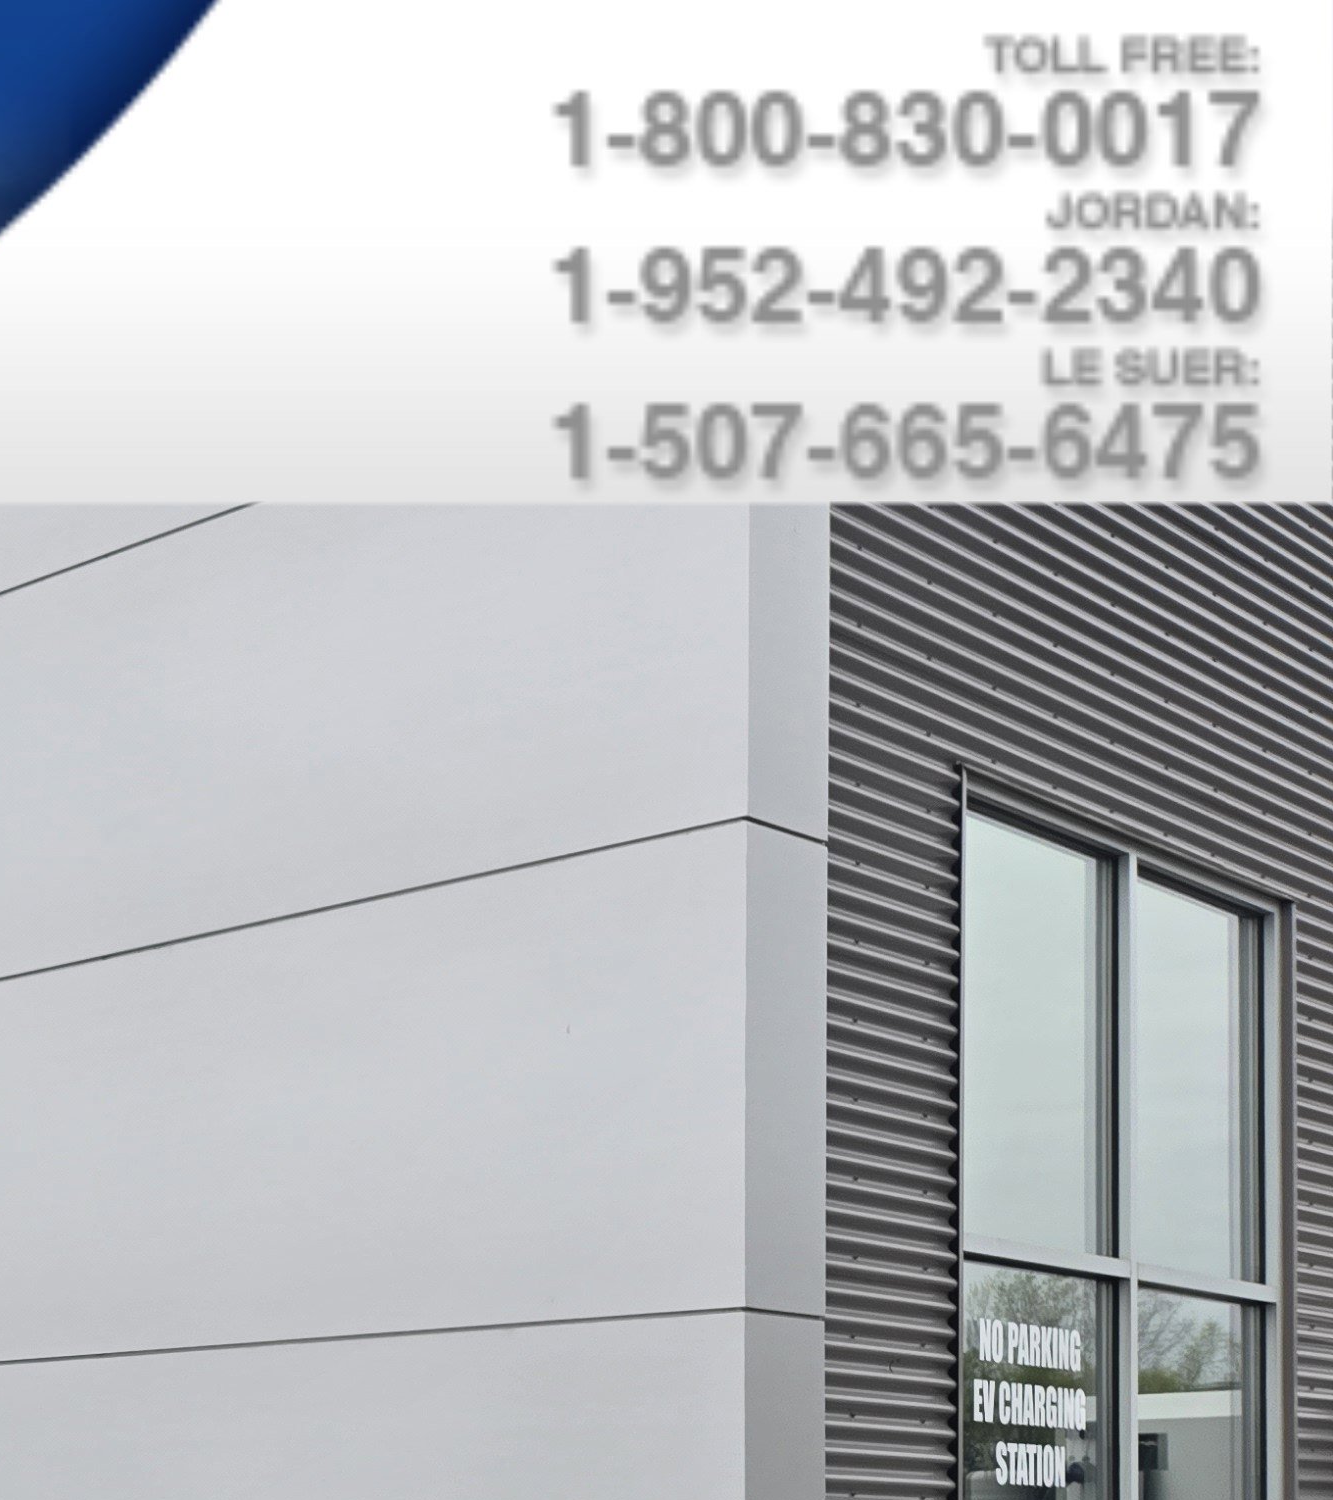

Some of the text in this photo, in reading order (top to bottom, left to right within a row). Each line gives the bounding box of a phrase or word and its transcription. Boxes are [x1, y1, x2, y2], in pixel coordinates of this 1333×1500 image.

[979, 1318, 1082, 1372] NO PARKING
[973, 1379, 1087, 1430] EV CHARGING
[995, 1441, 1066, 1488] STATION
